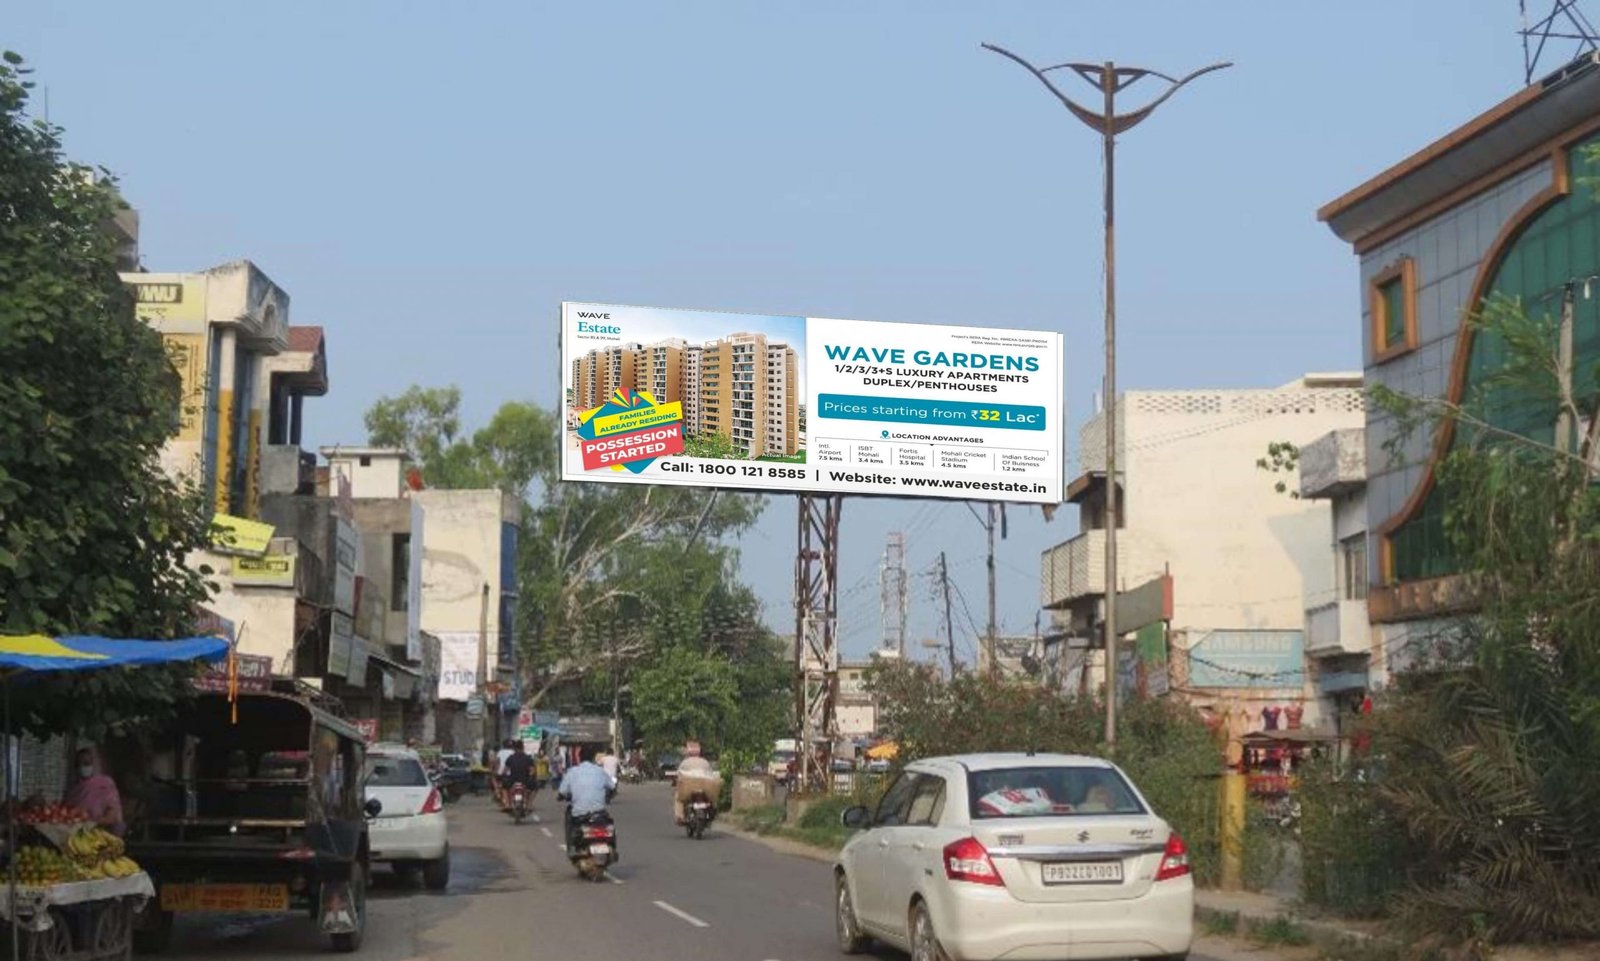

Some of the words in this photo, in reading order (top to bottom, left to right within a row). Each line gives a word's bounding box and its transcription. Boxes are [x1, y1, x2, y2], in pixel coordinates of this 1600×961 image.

[577, 312, 611, 320] WAVE
[577, 321, 621, 335] Estate
[824, 344, 905, 365] WAVE
[913, 350, 1040, 372] GARDENS
[835, 364, 893, 376] 1/2/3/3+S
[896, 368, 944, 380] LUXURY
[946, 371, 1030, 383] APARTMENTS
[863, 377, 998, 393] DUPLEX/PENTHOUSES
[619, 408, 656, 421] FAMILIES
[824, 401, 868, 414] Prices
[872, 405, 928, 419] starting
[931, 408, 967, 419] from
[970, 409, 1001, 422] ₹32
[599, 421, 638, 433] ALREADY
[639, 412, 678, 425] RESIDING
[586, 428, 678, 454] POSSESSION
[891, 433, 931, 441] LOCATION
[932, 435, 984, 444] ADVANTAGES
[599, 442, 666, 463] STARTED
[818, 448, 842, 457] Airport
[899, 447, 918, 455] Fortis
[899, 453, 926, 461] Hospital
[963, 451, 987, 459] Cricket
[1001, 453, 1022, 461] Indian
[1023, 454, 1046, 462] School
[870, 457, 884, 465] kms
[940, 456, 968, 464] Stadium
[660, 461, 694, 473] Call:
[699, 463, 737, 475] 1800
[742, 466, 763, 477] 121
[768, 467, 807, 480] 8585
[829, 471, 897, 485] Website:
[901, 475, 1047, 494] www.waveestate.in
